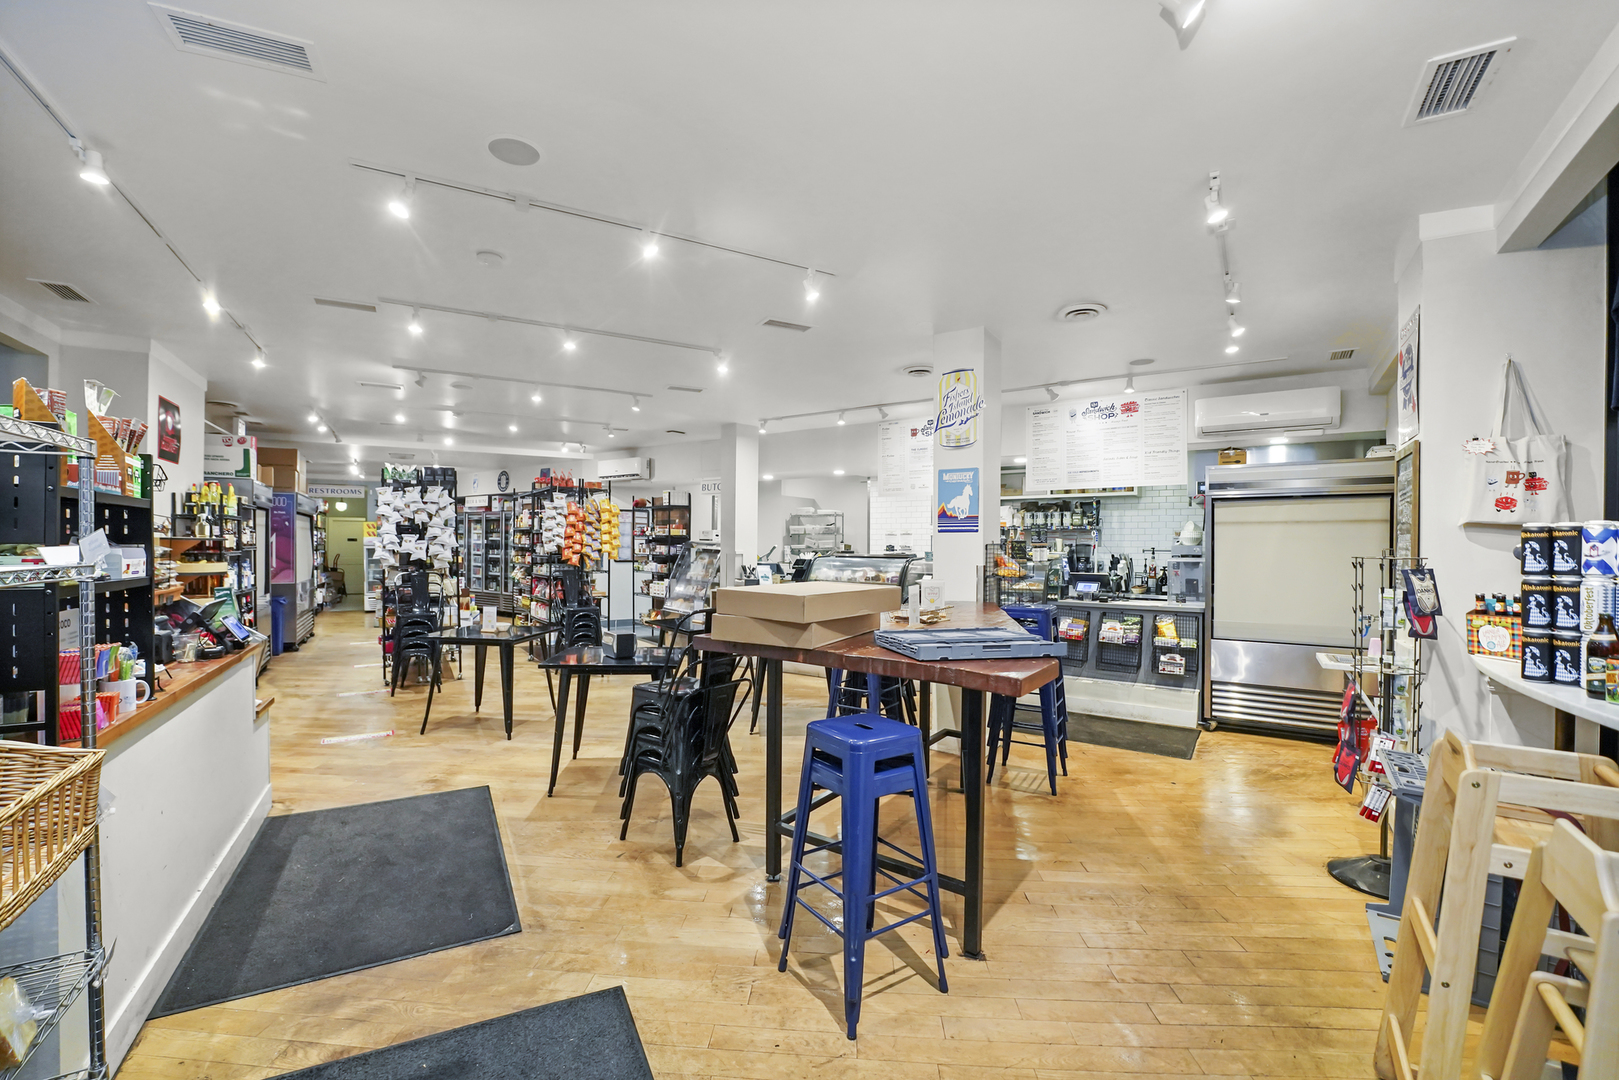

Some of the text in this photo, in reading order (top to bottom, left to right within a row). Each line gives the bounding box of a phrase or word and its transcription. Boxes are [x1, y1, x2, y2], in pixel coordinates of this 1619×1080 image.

[949, 392, 974, 413] Island
[1081, 402, 1118, 417] Sandwich
[934, 394, 985, 433] Lemonade
[308, 487, 363, 495] RESTROOMS
[1583, 587, 1595, 630] Oktoberfest
